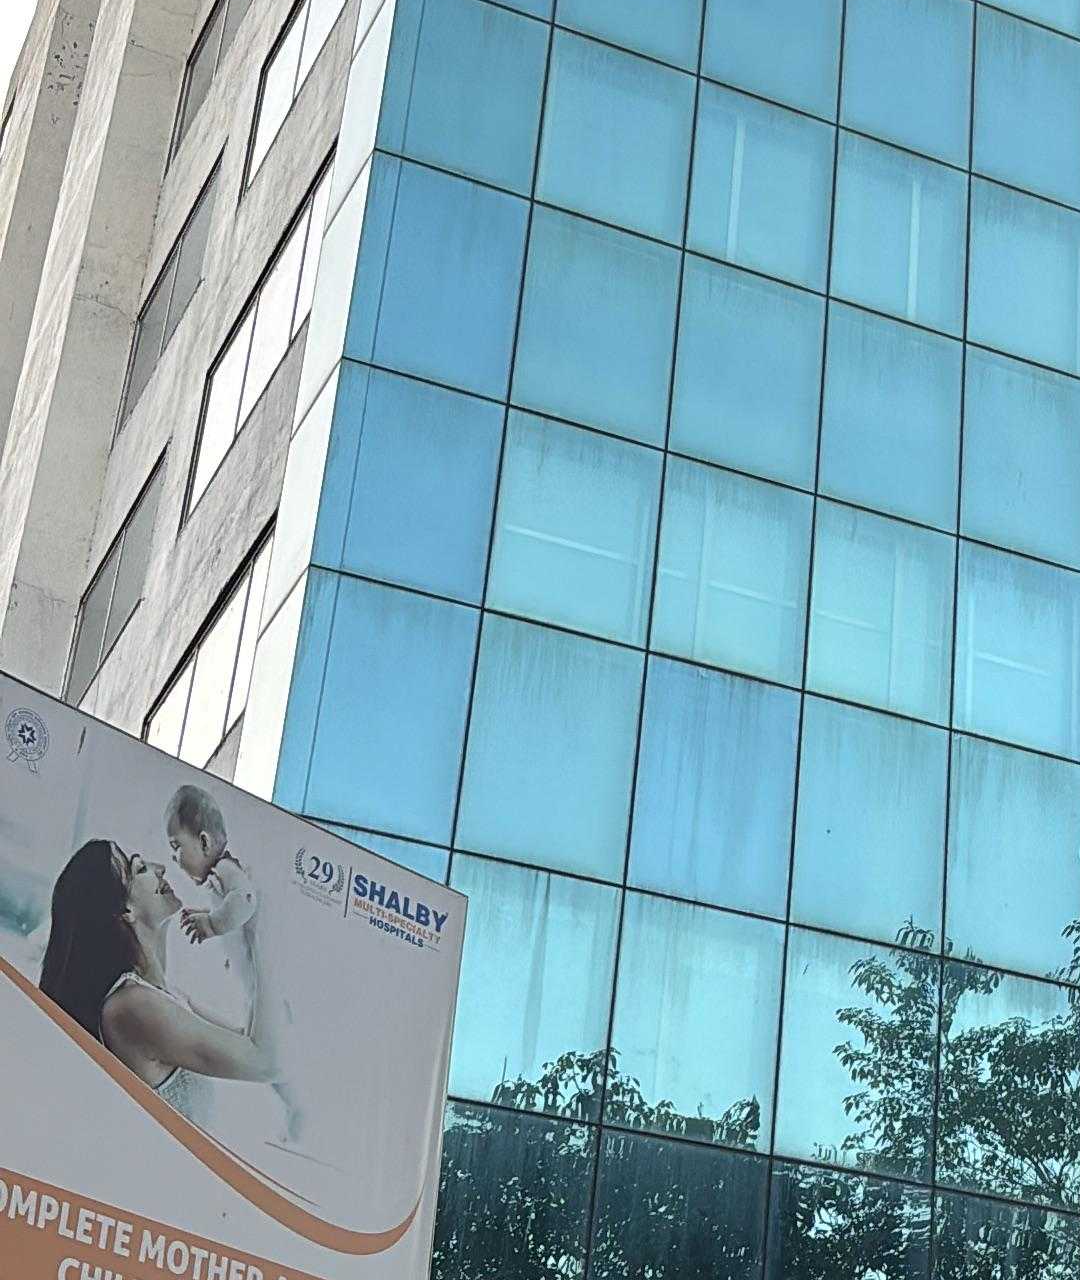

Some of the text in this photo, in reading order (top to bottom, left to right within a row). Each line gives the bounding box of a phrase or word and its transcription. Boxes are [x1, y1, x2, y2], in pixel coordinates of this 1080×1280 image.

[308, 856, 334, 884] 29
[353, 874, 449, 933] SHALBY
[353, 897, 441, 944] MULTI-SPECIALTY
[369, 915, 424, 948] HOSPITALS
